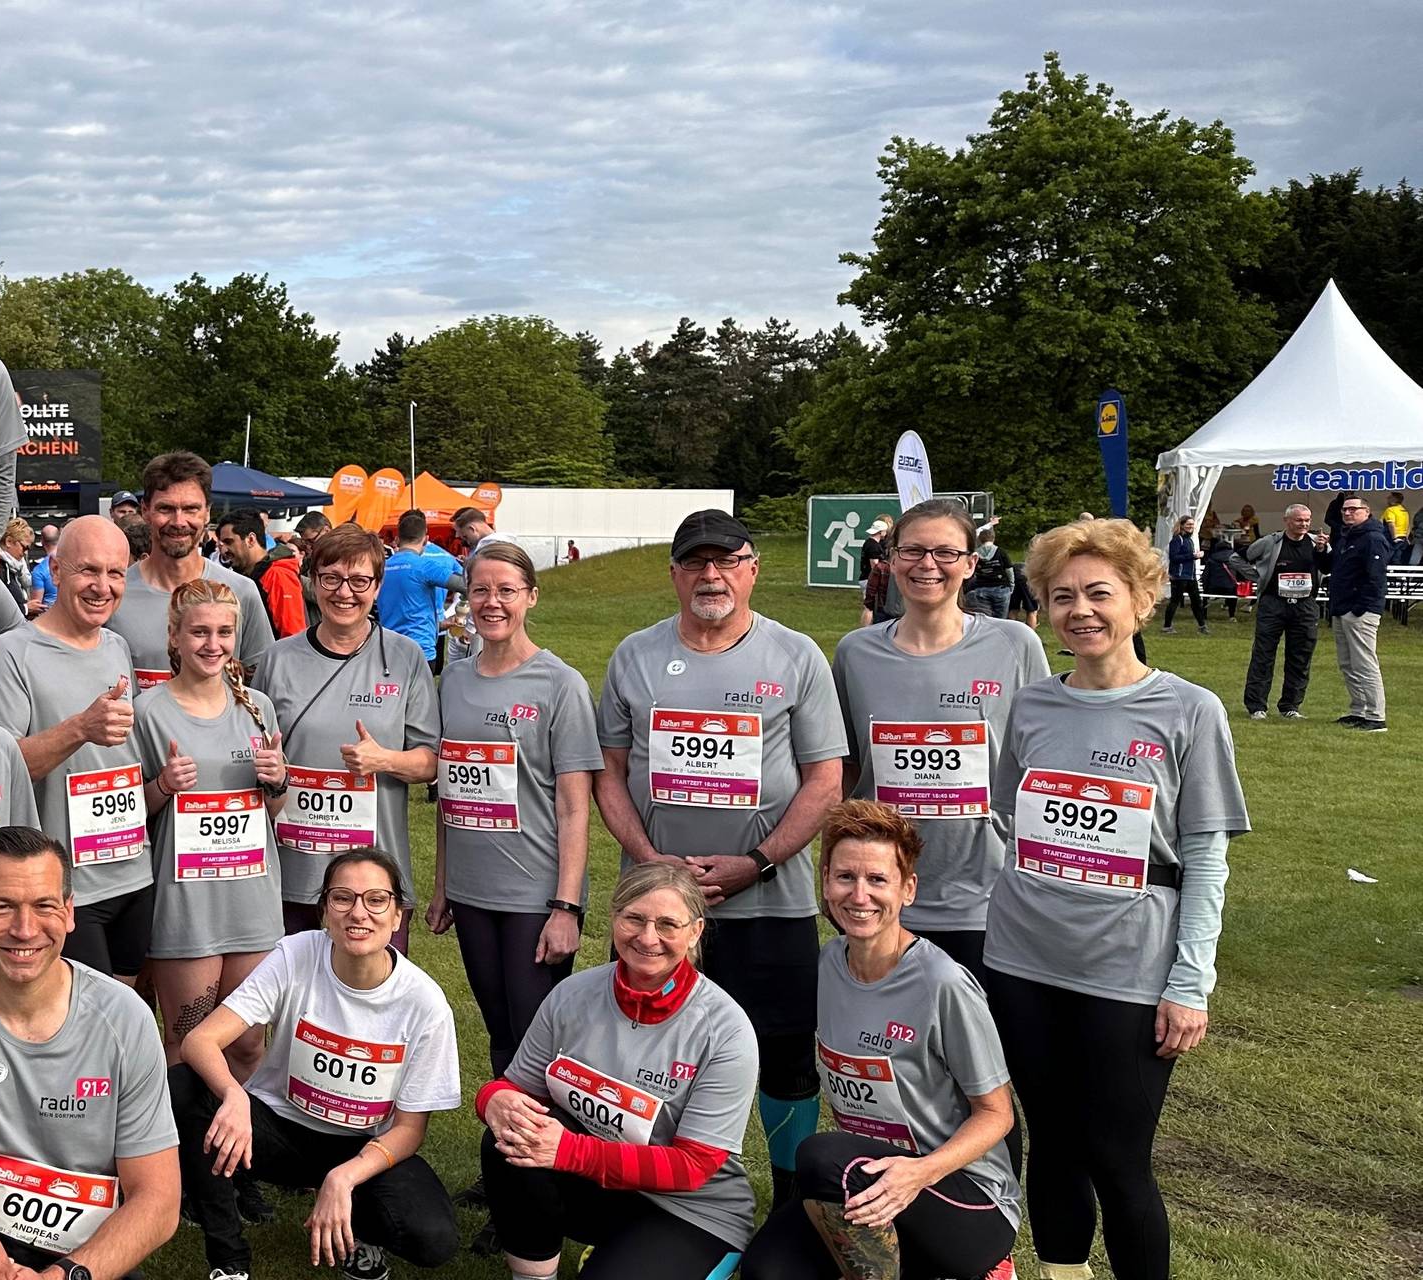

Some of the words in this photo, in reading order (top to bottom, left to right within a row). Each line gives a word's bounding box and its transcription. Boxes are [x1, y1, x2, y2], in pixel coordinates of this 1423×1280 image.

[349, 692, 383, 704] radio
[379, 686, 400, 697] 91.2
[724, 691, 763, 705] radio
[760, 684, 784, 698] 91.2
[939, 692, 980, 705] radio
[976, 683, 1001, 696] 91.2
[485, 712, 518, 726] radio
[516, 707, 538, 721] 91.2
[671, 736, 735, 760] 5994
[1091, 750, 1137, 767] radio
[1135, 744, 1163, 762] 91.2
[685, 760, 718, 769] ALBERT
[894, 749, 961, 771] 5993
[448, 764, 491, 786] 5991
[672, 778, 702, 786] STARTZEIT
[297, 791, 353, 813] 6010
[459, 787, 482, 795] BIANCA
[92, 791, 136, 817] 5996
[199, 814, 250, 836] 5997
[308, 813, 340, 822] CHRISTA
[1043, 800, 1118, 834] 5992
[212, 838, 241, 846] MELISSA
[1054, 828, 1100, 842] SVITLANA
[1043, 849, 1076, 860] STARTZEIT
[1078, 855, 1096, 863] 18:45
[1097, 857, 1110, 866] Uhr
[1086, 843, 1114, 853] Dortmund
[859, 1031, 893, 1050] radio
[891, 1024, 914, 1043] 91.2
[313, 1052, 377, 1086] 6016
[637, 1067, 678, 1089] radio
[40, 1095, 87, 1112] radio
[82, 1081, 110, 1097] 91.2
[311, 1091, 341, 1105] STARTZEIT
[827, 1071, 877, 1104] 6002
[568, 1090, 624, 1133] 6004
[842, 1100, 865, 1110] TANJA
[3, 1192, 84, 1233] 6007
[12, 1221, 60, 1241] ANDREAS
